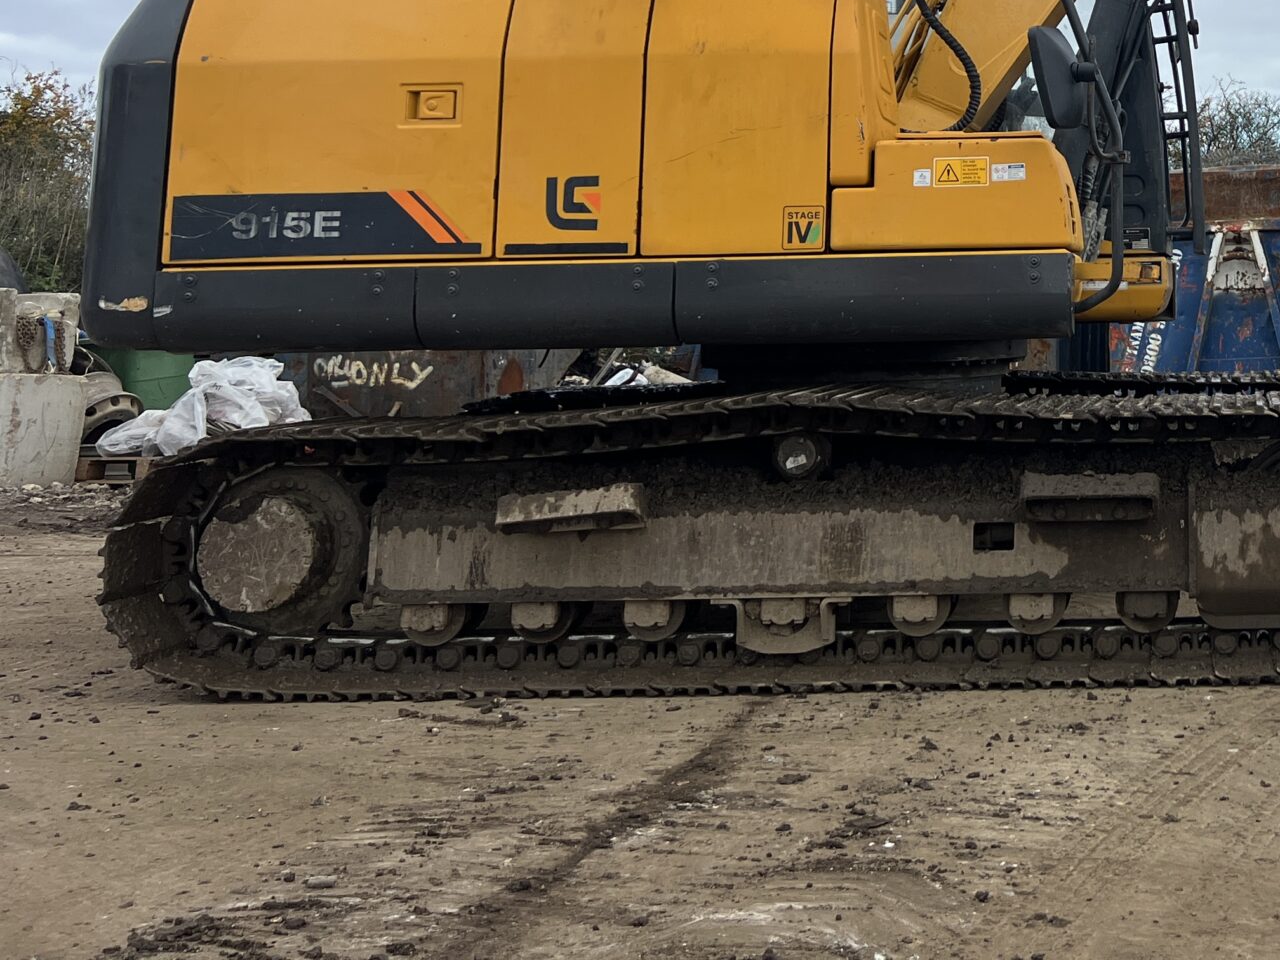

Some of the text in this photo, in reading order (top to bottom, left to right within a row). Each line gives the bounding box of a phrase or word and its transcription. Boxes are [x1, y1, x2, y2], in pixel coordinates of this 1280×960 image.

[232, 211, 341, 240] 915E
[787, 211, 820, 220] STAGE
[787, 221, 813, 243] IV
[352, 360, 434, 390] ONLY
